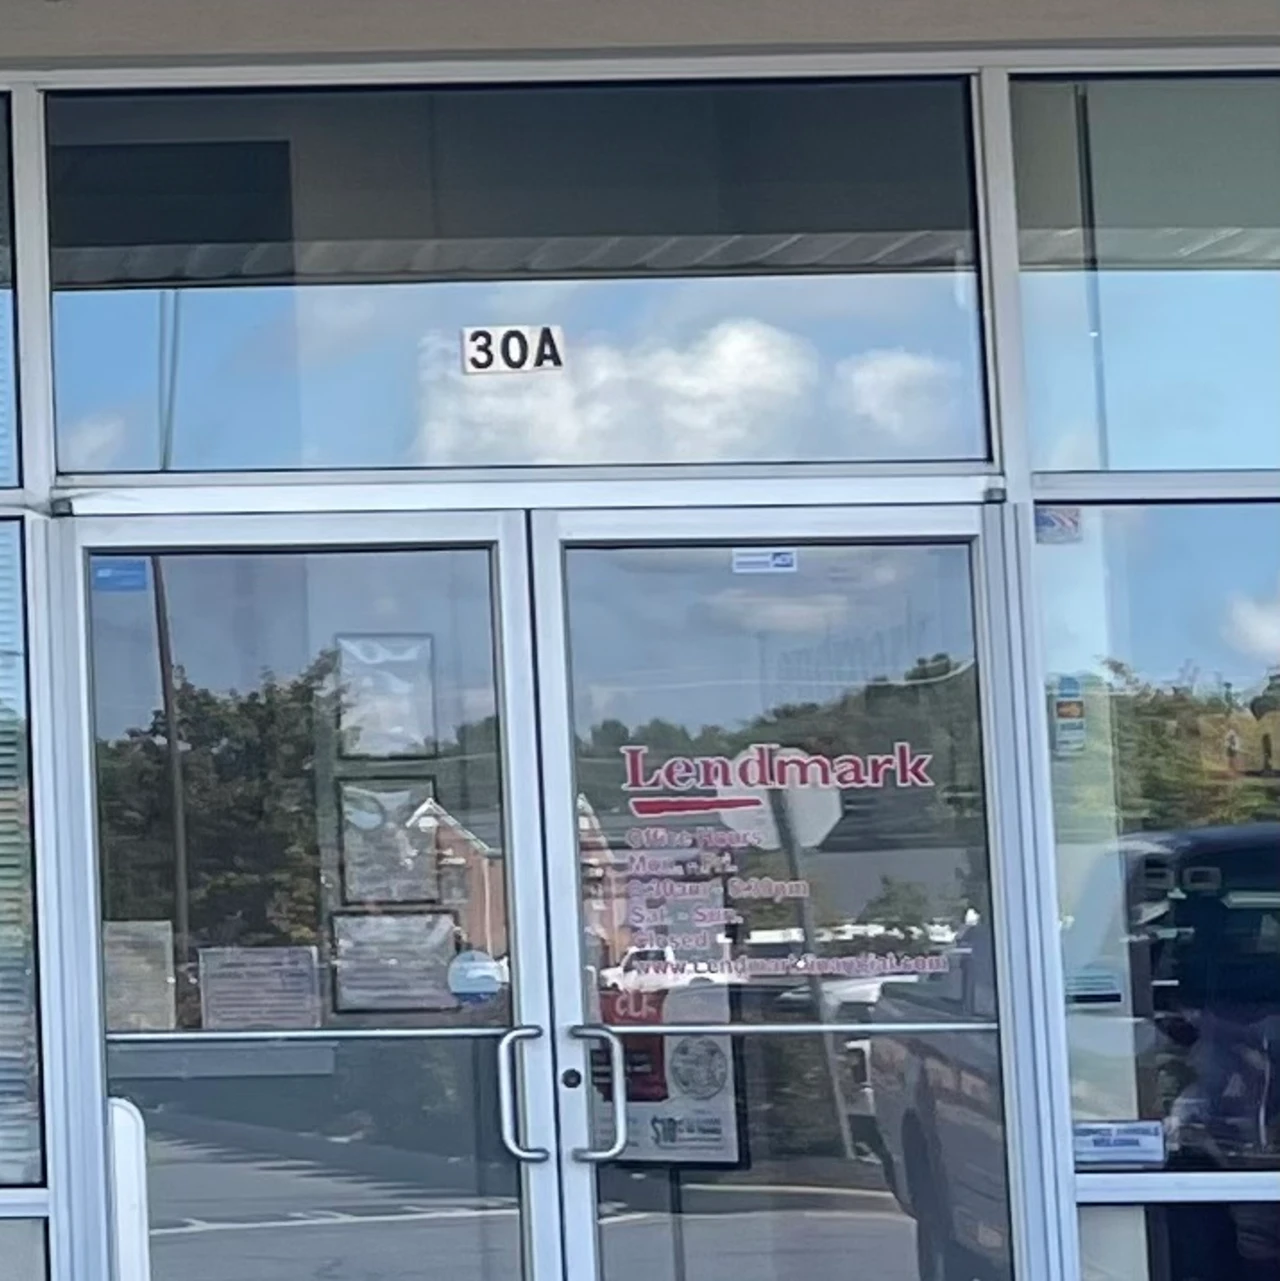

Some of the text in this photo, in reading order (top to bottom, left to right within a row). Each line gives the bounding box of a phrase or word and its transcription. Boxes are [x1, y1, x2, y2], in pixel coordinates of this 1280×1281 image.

[468, 325, 564, 370] 30A
[620, 742, 935, 790] Lendmark
[633, 929, 710, 949] Closed
